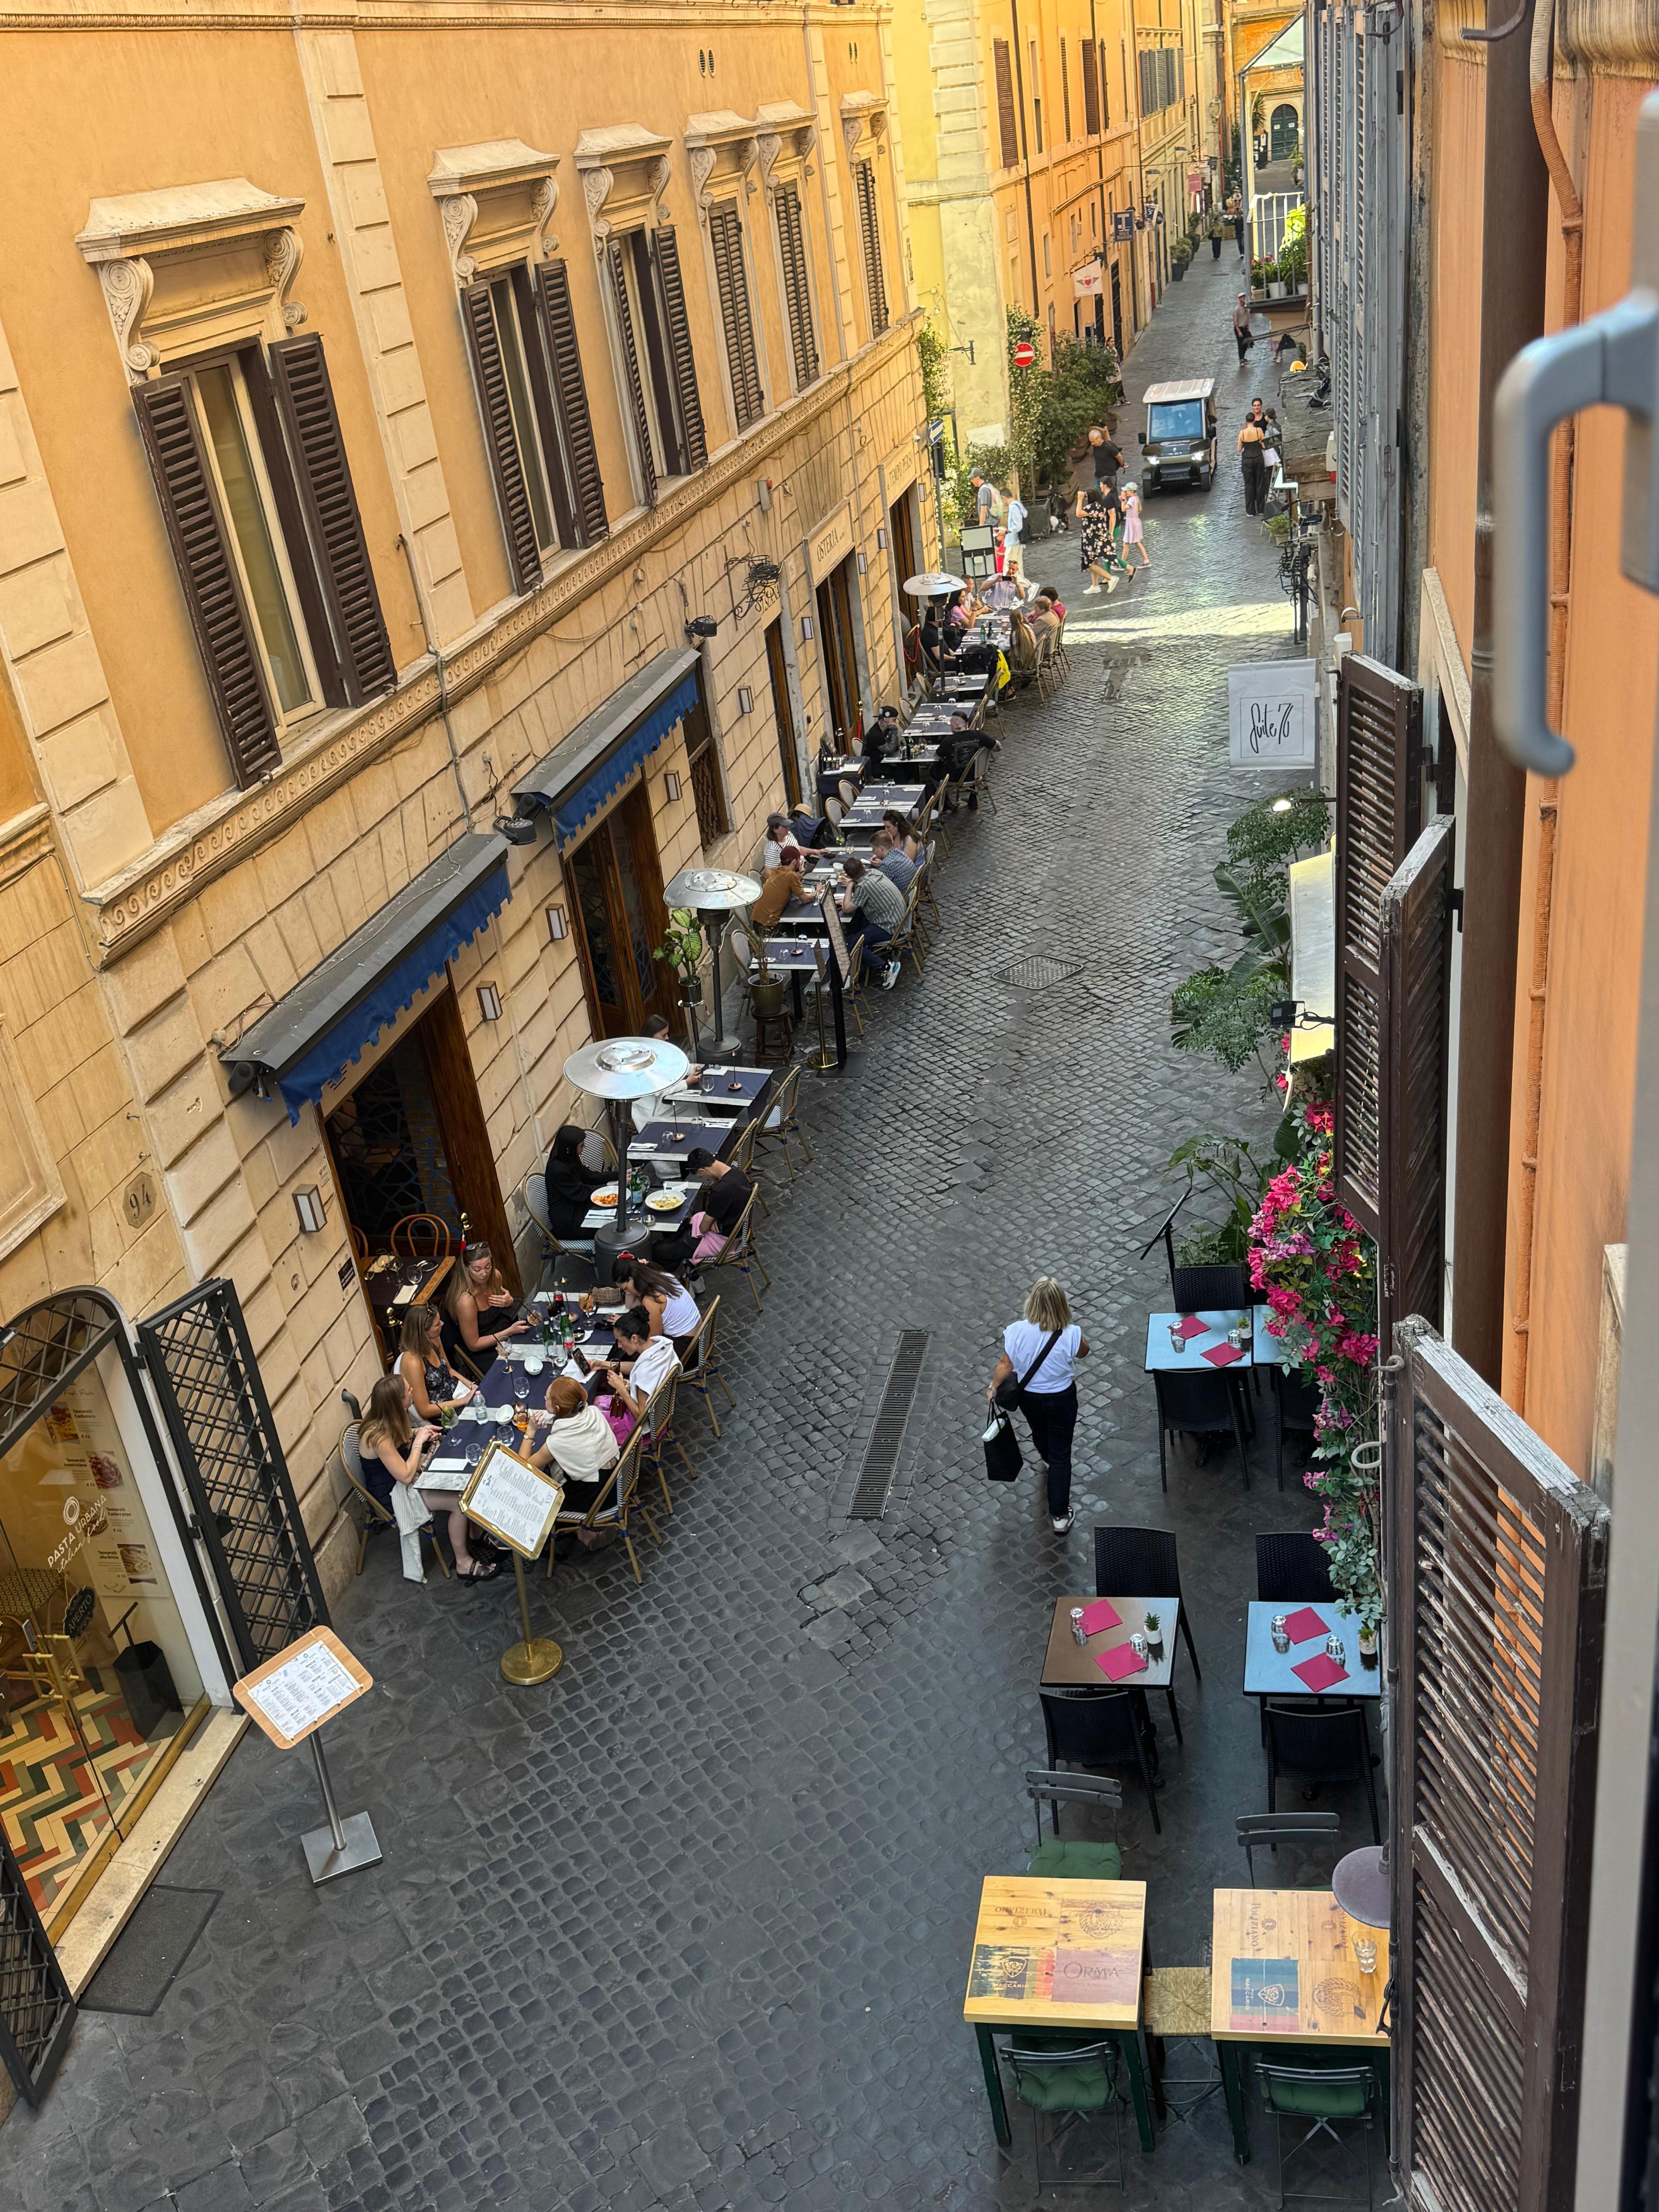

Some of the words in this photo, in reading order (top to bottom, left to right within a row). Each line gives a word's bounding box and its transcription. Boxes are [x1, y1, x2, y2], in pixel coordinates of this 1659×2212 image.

[817, 527, 838, 562] OSTERIA
[1250, 703, 1277, 754] Suite
[130, 1183, 152, 1219] 94
[47, 1532, 76, 1568] PASTA
[75, 1495, 107, 1533] URBANA
[69, 1594, 92, 1633] APERTO
[995, 1907, 1046, 1917] POLIZIANO
